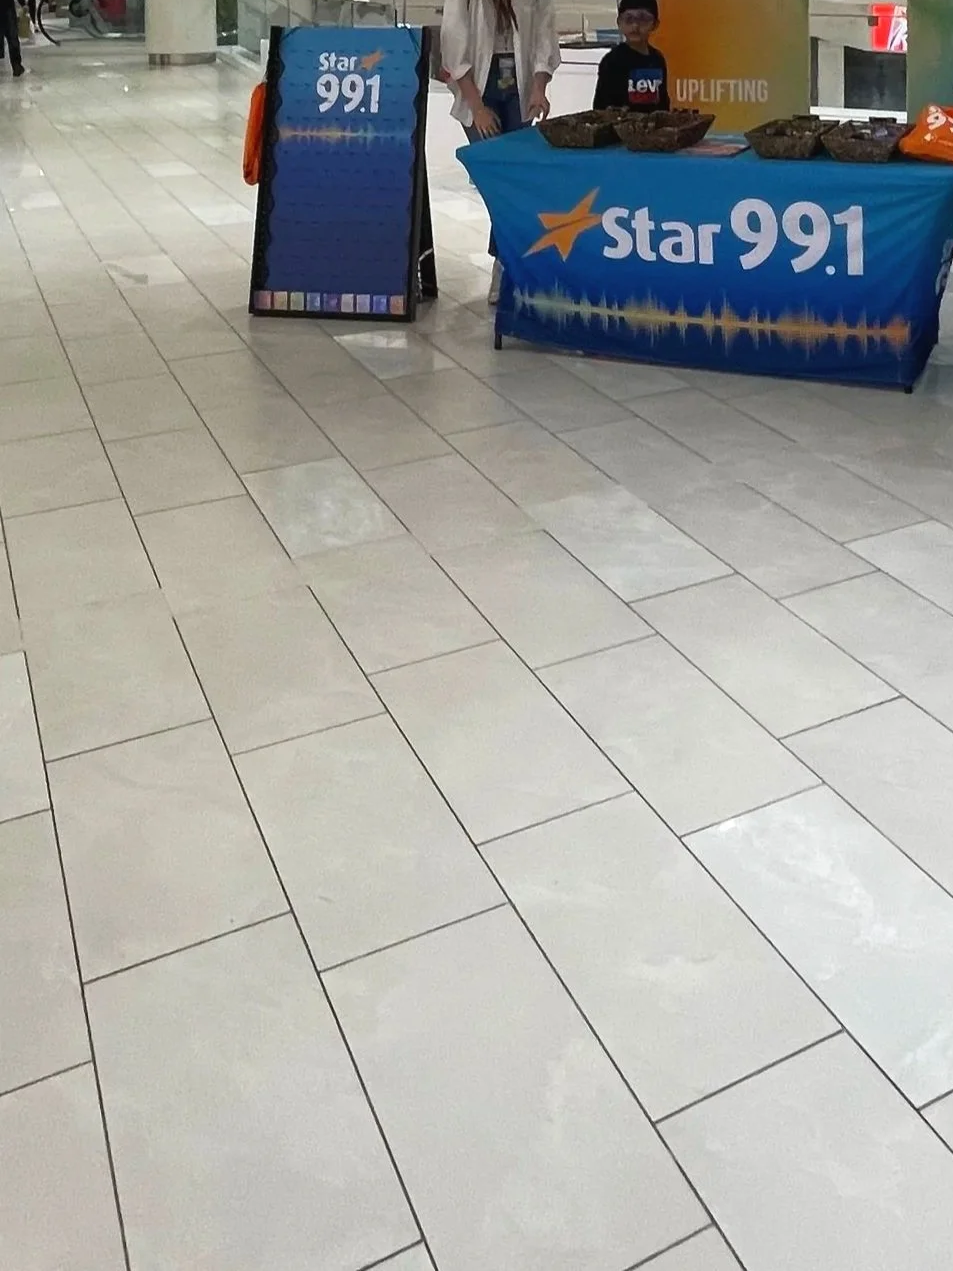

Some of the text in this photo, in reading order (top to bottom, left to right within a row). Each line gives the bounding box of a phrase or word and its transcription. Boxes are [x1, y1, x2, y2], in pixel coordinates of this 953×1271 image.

[319, 52, 358, 71] Star
[316, 73, 380, 114] 99.1
[676, 78, 768, 103] UPLIFTING
[602, 206, 721, 265] Star
[730, 198, 864, 276] 99.1
